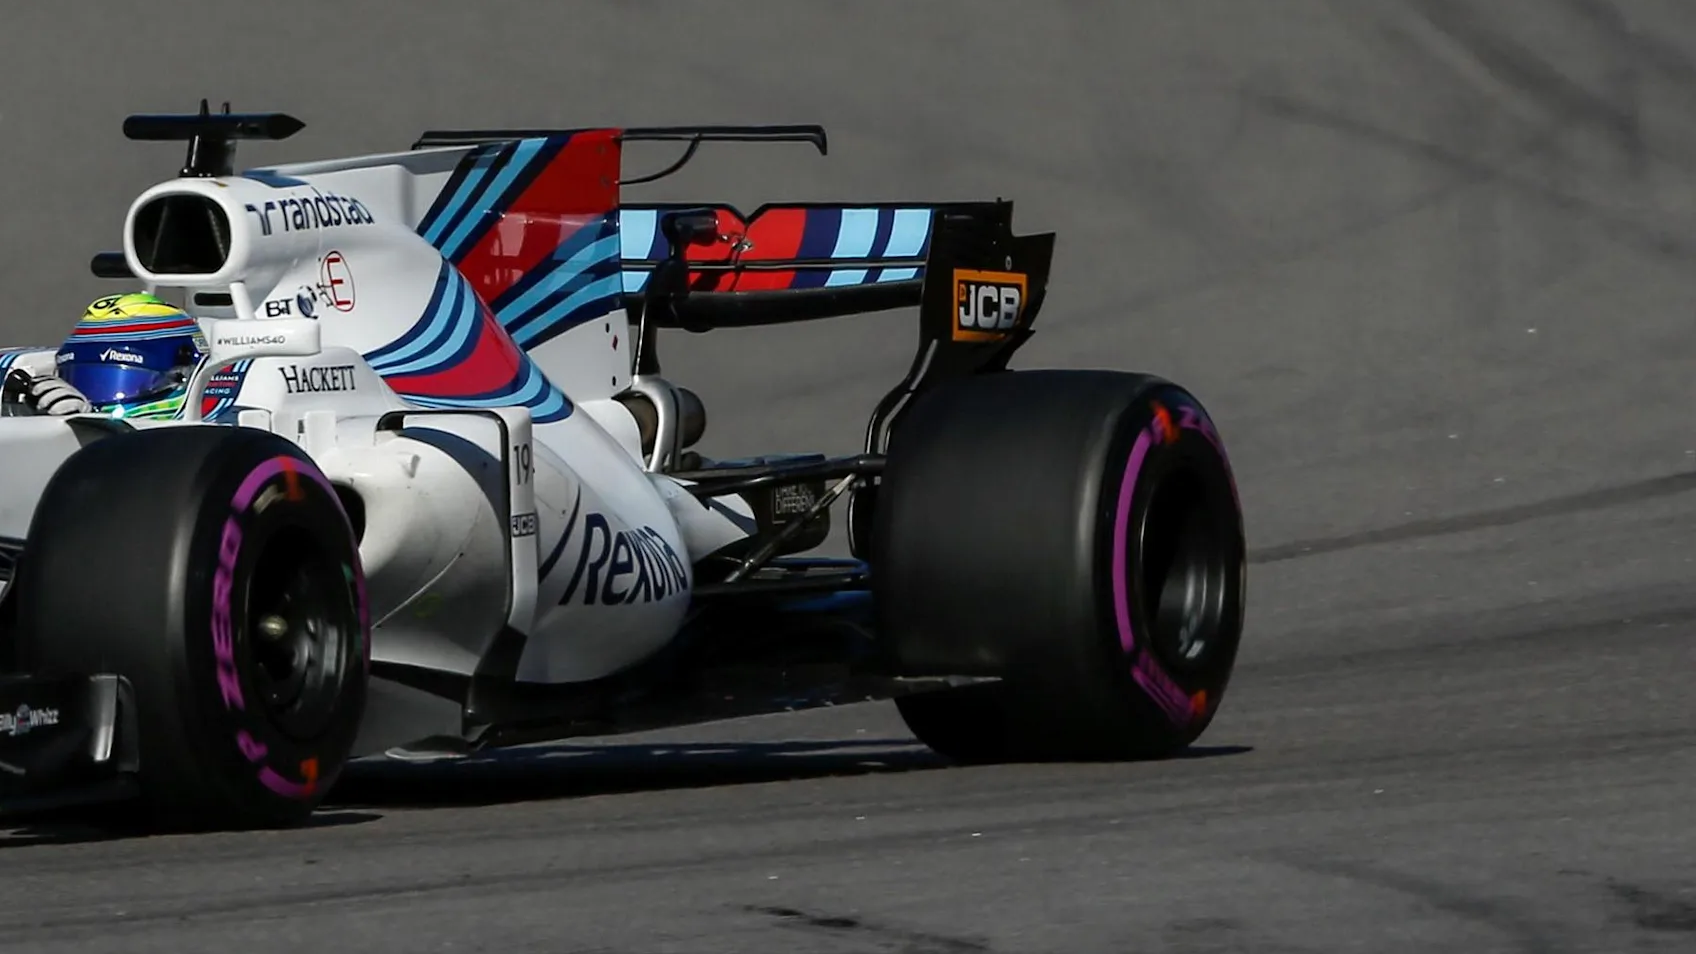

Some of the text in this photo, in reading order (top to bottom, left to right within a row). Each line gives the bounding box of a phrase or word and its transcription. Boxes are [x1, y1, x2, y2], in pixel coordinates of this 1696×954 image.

[278, 189, 375, 232] randstad
[265, 298, 293, 318] BT
[958, 284, 1021, 329] JCB
[109, 349, 144, 364] Rexona
[217, 335, 286, 346] #WILLIAMS40
[278, 364, 357, 394] HACKETT
[513, 443, 531, 486] 19
[558, 512, 689, 606] Rexona
